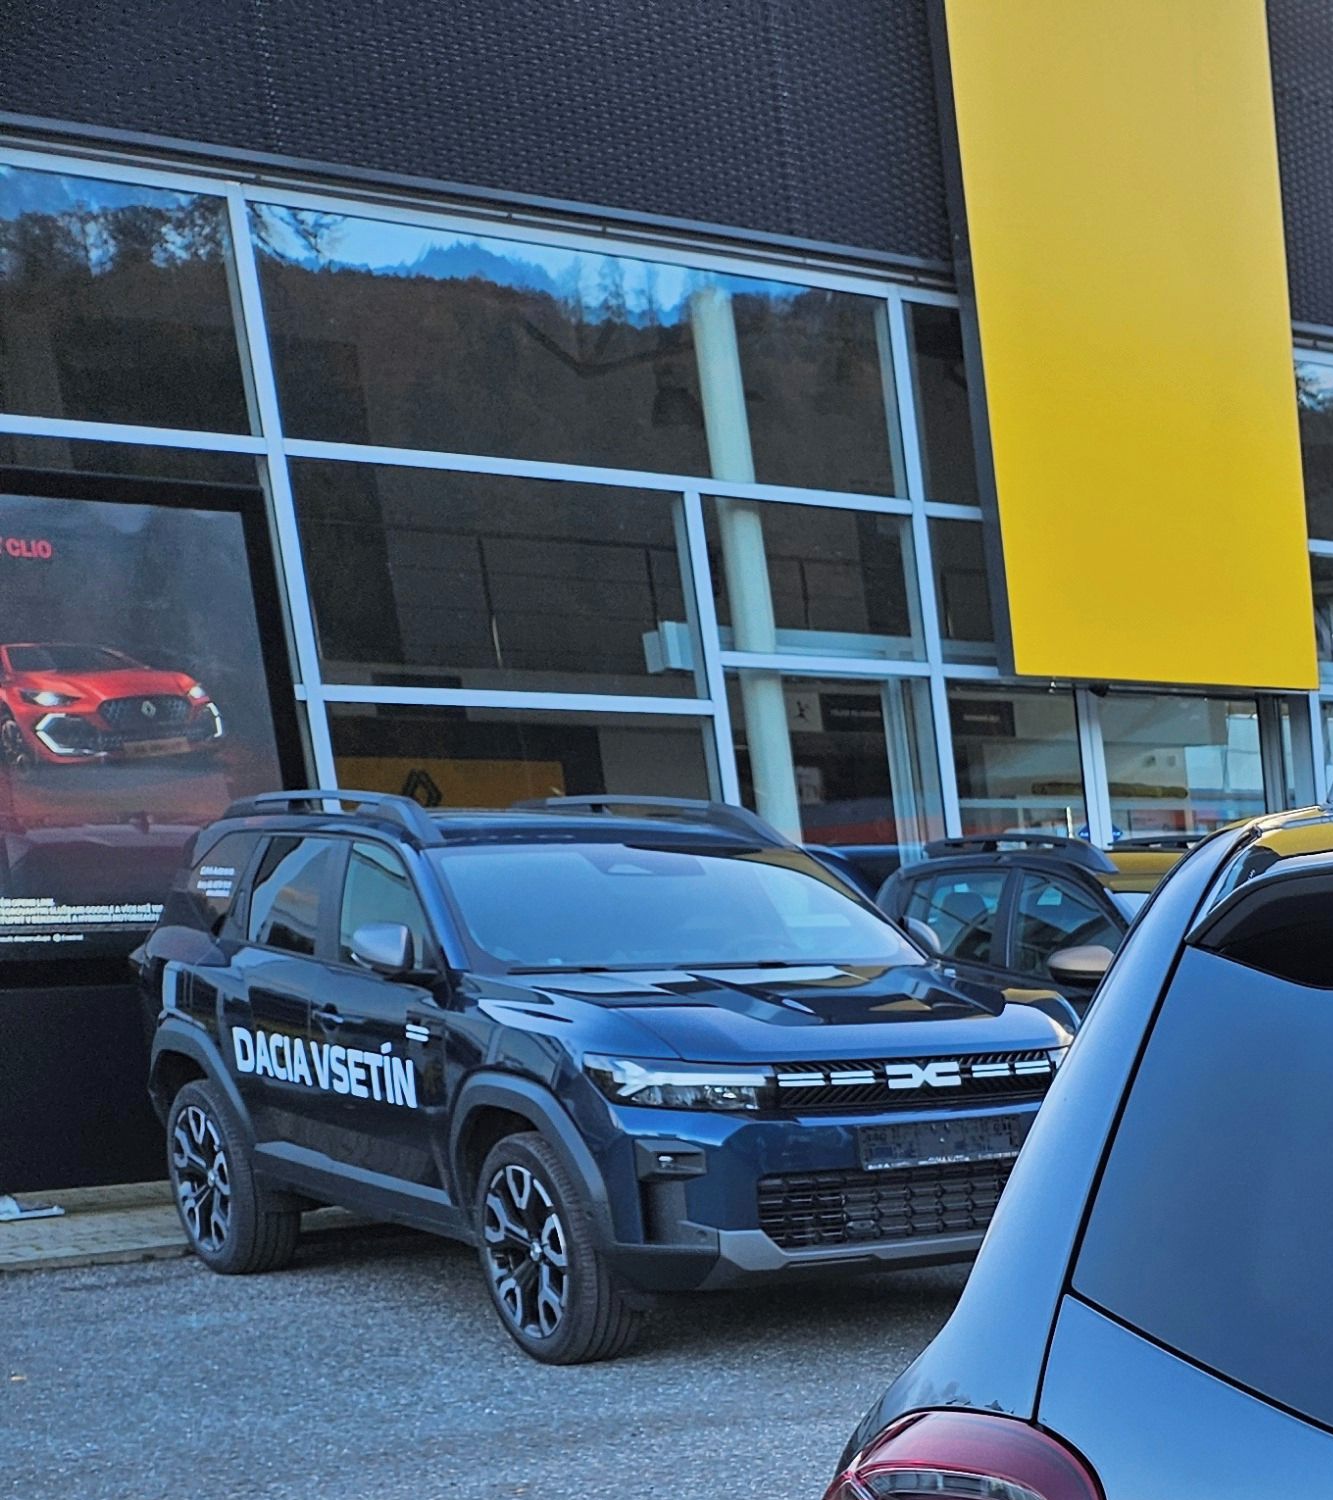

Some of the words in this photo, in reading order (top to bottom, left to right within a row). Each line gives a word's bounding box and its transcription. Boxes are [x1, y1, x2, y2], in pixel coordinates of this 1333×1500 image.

[6, 537, 52, 559] CLIO
[231, 1026, 313, 1087] DACIA
[309, 1041, 418, 1109] VSETÍN
